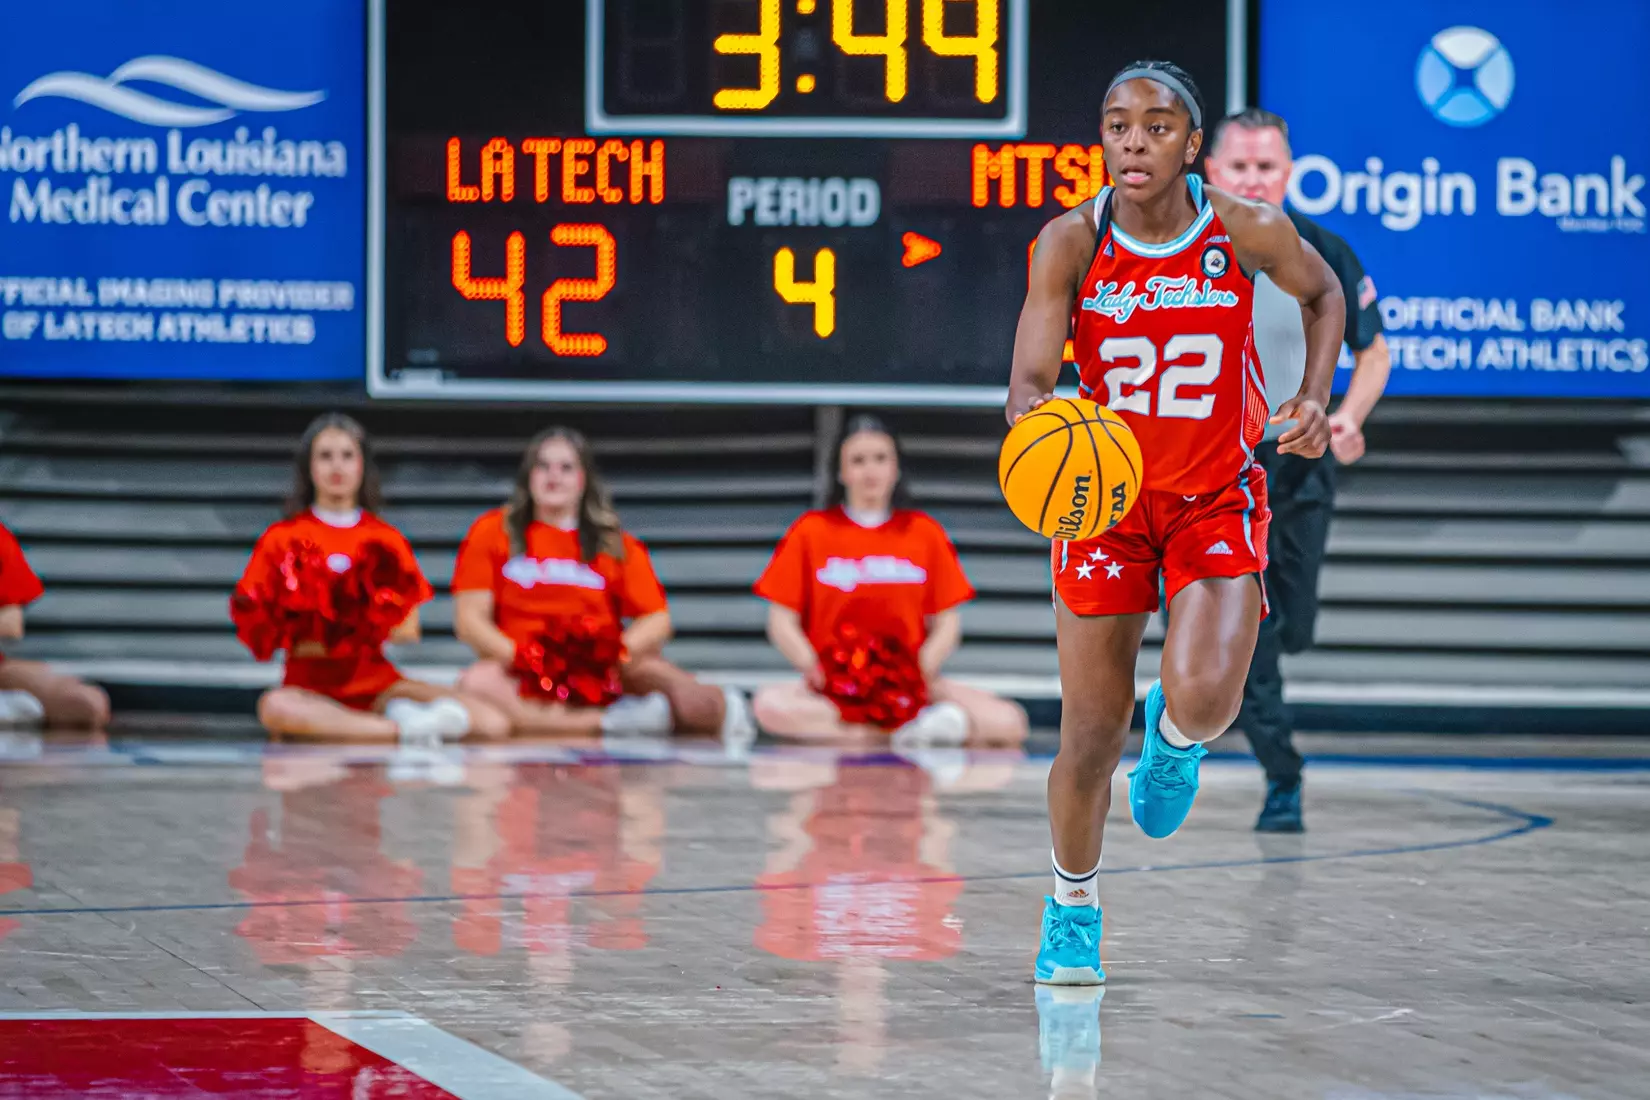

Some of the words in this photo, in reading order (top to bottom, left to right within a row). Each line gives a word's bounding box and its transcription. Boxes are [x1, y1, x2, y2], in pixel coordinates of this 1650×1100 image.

[167, 126, 348, 177] Louisiana
[9, 174, 169, 225] Medical
[175, 179, 314, 228] Center
[727, 177, 880, 227] PERIOD
[1287, 154, 1476, 231] Origin
[1496, 155, 1646, 217] Bank
[0, 276, 94, 307] FICIAL
[217, 279, 355, 311] PROVIDER
[450, 222, 617, 357] 42
[773, 246, 836, 338] 4
[1081, 279, 1140, 324] Lady
[1138, 274, 1239, 311] Techsters
[1377, 296, 1525, 332] OFFICIAL
[1530, 299, 1625, 333] BANK
[2, 310, 40, 340] OF
[44, 310, 154, 342] LATECH
[157, 312, 316, 345] ATHLETICS
[1098, 333, 1224, 420] 22
[1476, 338, 1649, 374] ATHLETICS
[1104, 481, 1127, 529] CAA
